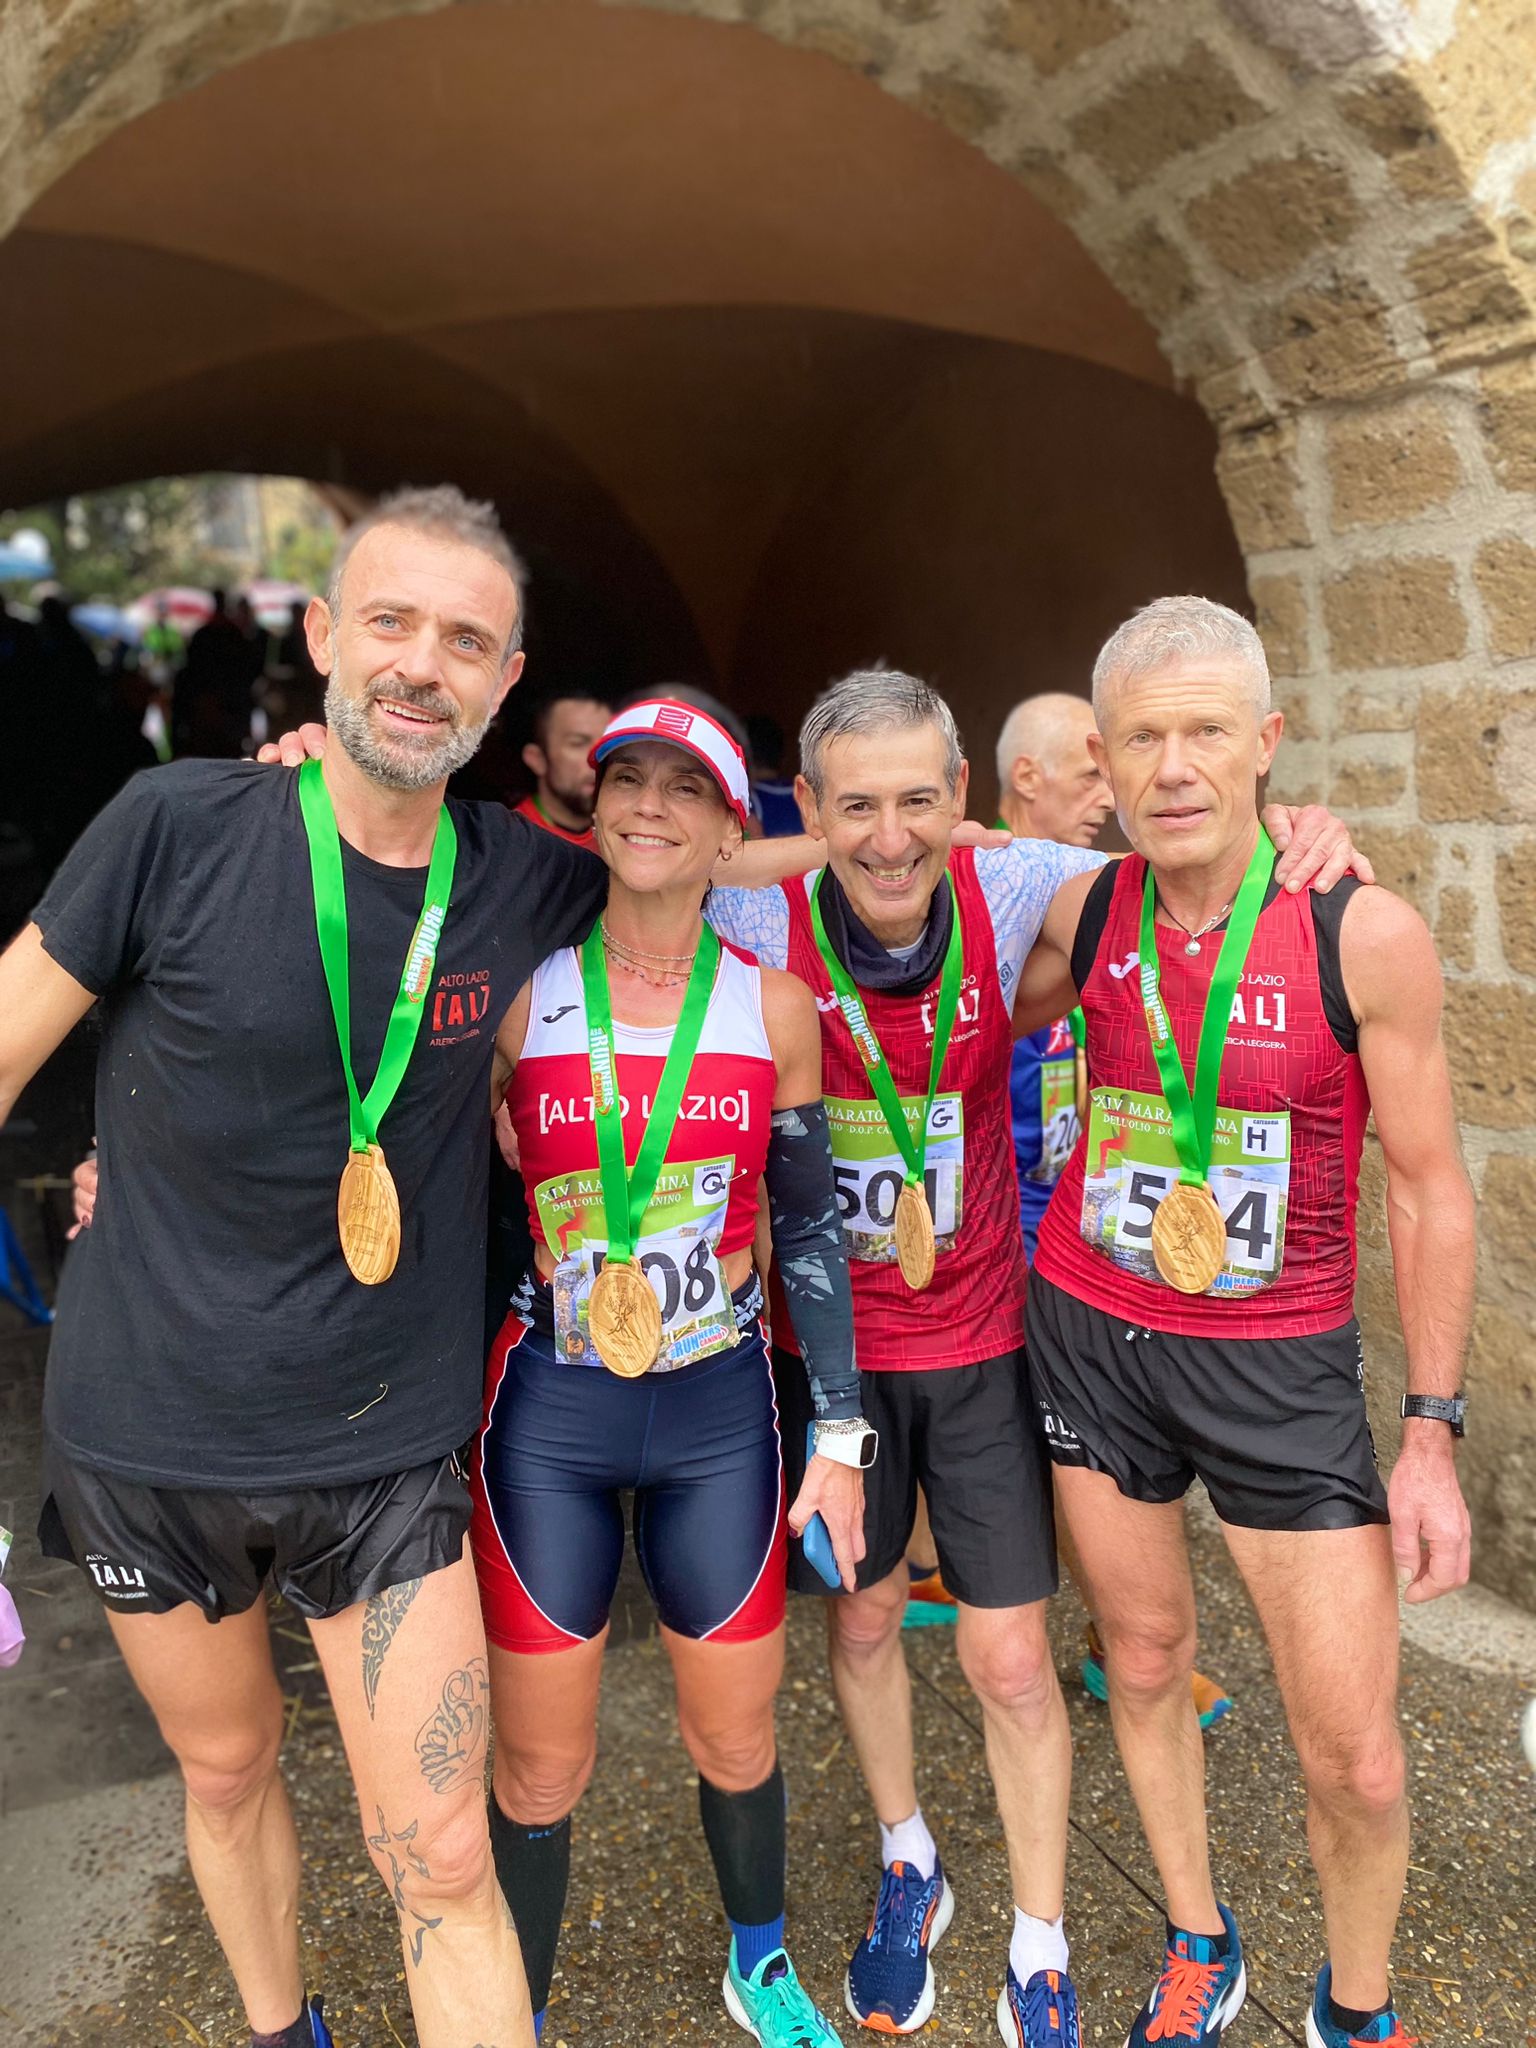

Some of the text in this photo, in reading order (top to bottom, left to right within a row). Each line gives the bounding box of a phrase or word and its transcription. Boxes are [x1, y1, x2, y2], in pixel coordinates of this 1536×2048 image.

[438, 974, 465, 987] ALTO
[1247, 973, 1286, 987] LAZIO
[1142, 969, 1169, 1040] RUNNERS
[842, 1000, 880, 1063] RUNNERS
[1224, 1037, 1287, 1050] ETICA LEGGERA
[590, 1033, 614, 1106] RUNNERS
[824, 1104, 920, 1122] MARATONA
[931, 1107, 953, 1128] G
[1095, 1095, 1239, 1134] XIV MARANA
[1103, 1114, 1151, 1132] DELL'OLIO
[1247, 1126, 1267, 1151] H
[540, 1184, 569, 1205] XIV
[1122, 1171, 1272, 1259] 54
[593, 1239, 716, 1324] 08
[1214, 1273, 1261, 1288] UNNERS
[675, 1325, 720, 1357] RUNNERS
